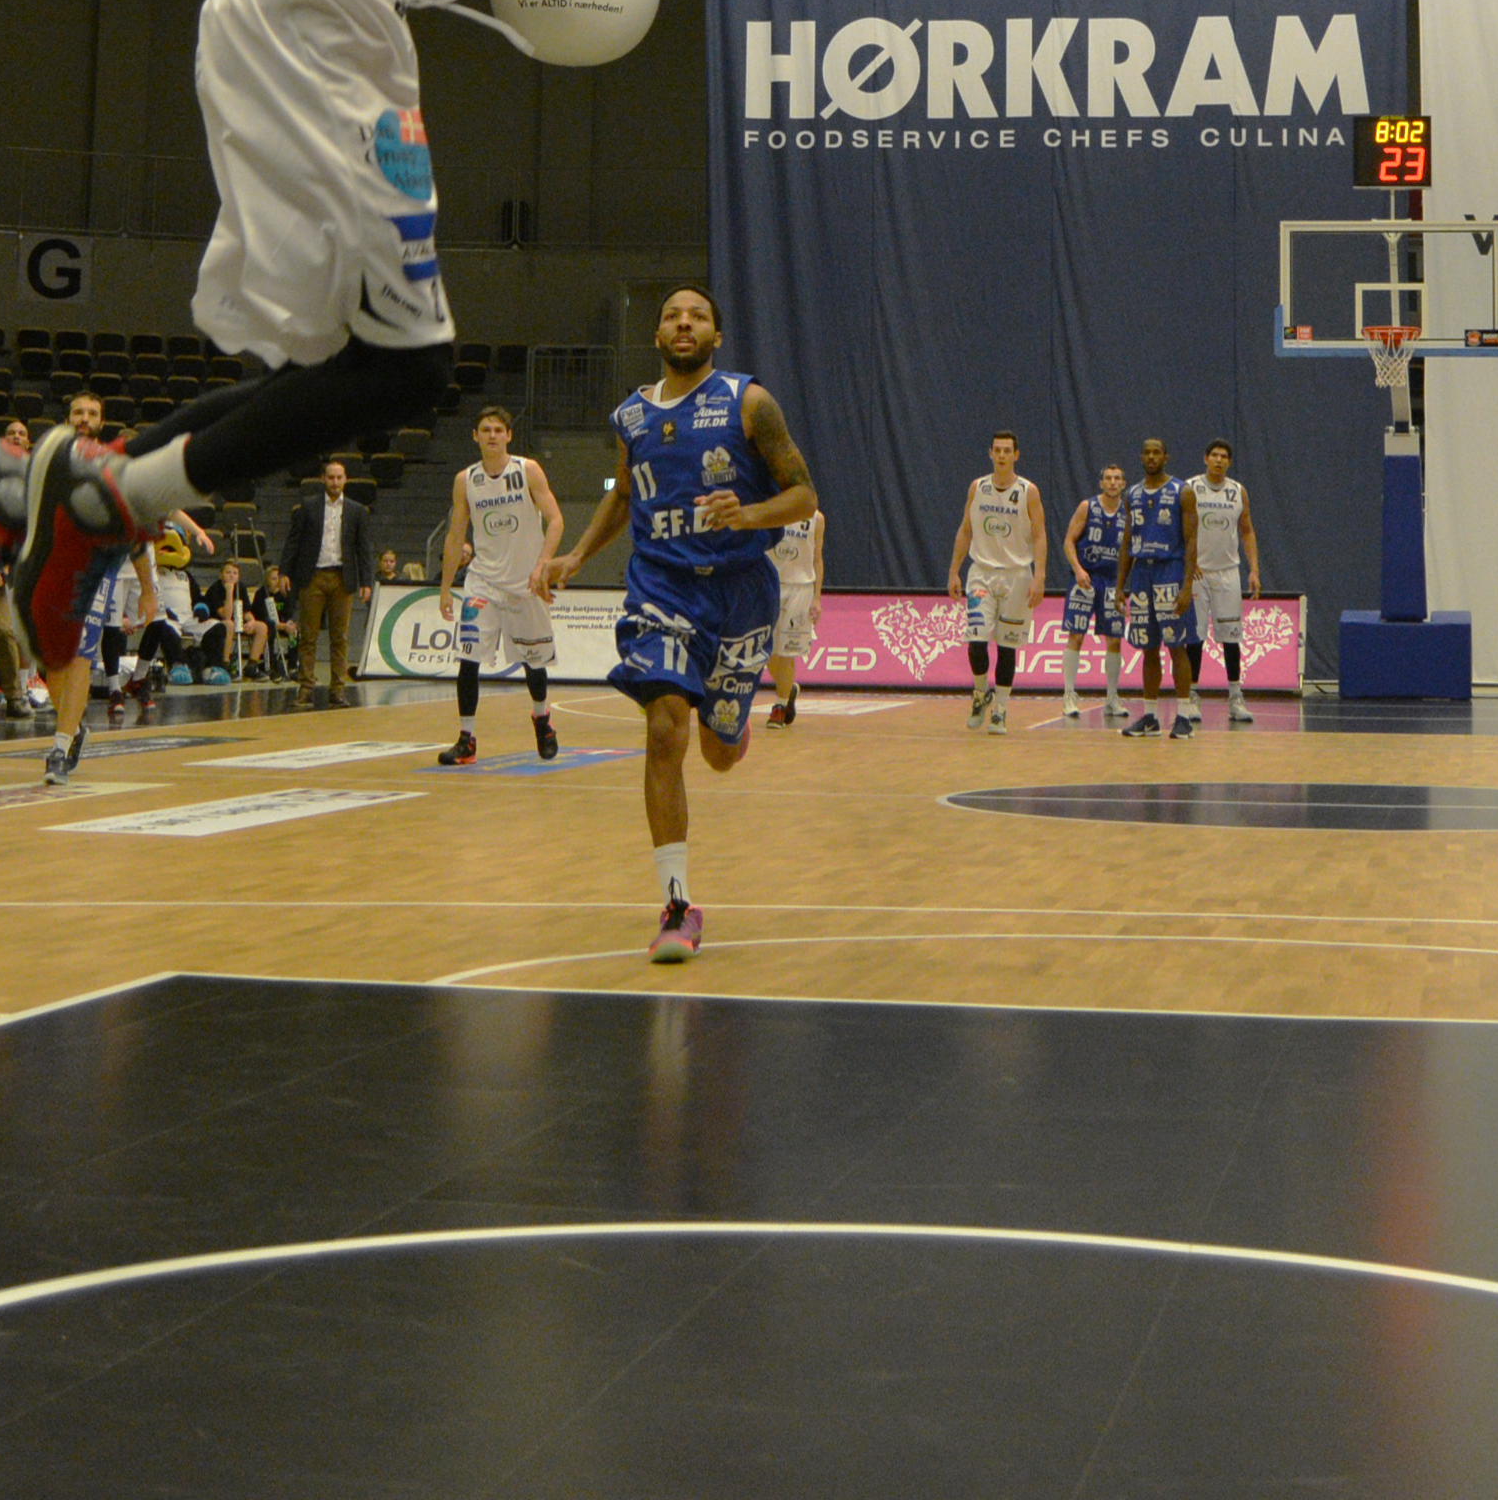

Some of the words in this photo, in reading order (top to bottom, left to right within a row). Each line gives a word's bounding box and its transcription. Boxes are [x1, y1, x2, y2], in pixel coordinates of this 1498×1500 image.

[541, 0, 567, 8] ALTID
[744, 13, 1371, 121] HØRKRAM
[744, 129, 1017, 150] FOODSERVICE
[1042, 127, 1170, 149] CHEFS
[1199, 125, 1346, 149] CULINA
[1375, 121, 1424, 143] 8:02
[1378, 147, 1426, 182] 23
[26, 238, 84, 300] G
[502, 470, 524, 492] 10
[632, 461, 657, 501] 11
[1008, 490, 1020, 505] 4
[1223, 488, 1238, 503] 12
[1130, 508, 1145, 527] 15
[1088, 526, 1103, 543] 10
[551, 613, 604, 621] efonnummer
[1074, 614, 1088, 630] 10
[661, 636, 691, 675] 11
